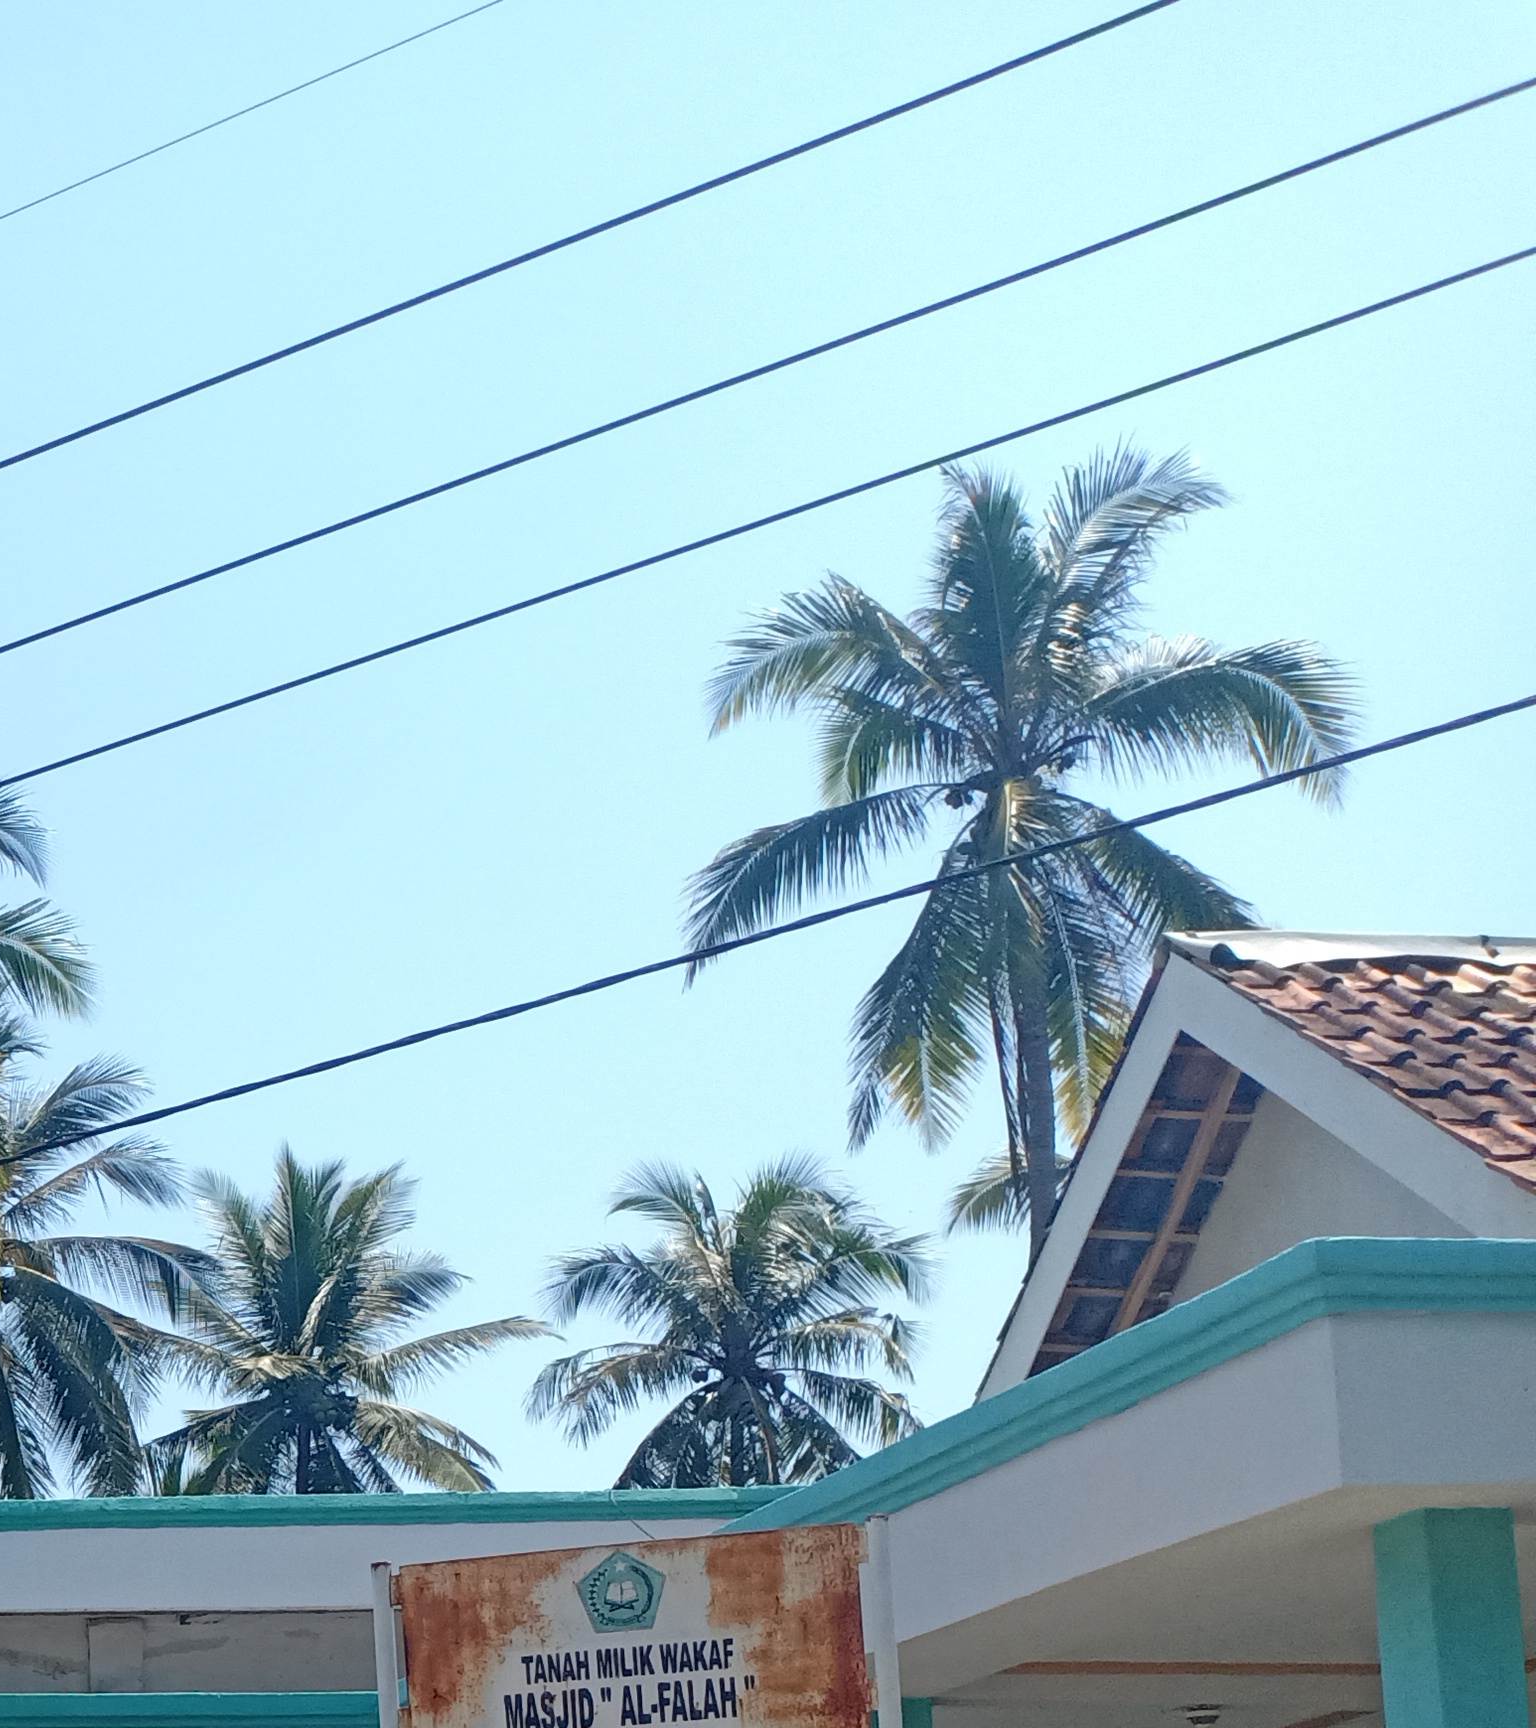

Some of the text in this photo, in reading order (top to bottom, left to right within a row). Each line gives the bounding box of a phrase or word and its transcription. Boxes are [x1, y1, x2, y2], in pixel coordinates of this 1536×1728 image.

[521, 1638, 734, 1685] TANAH MILIK WAKAF
